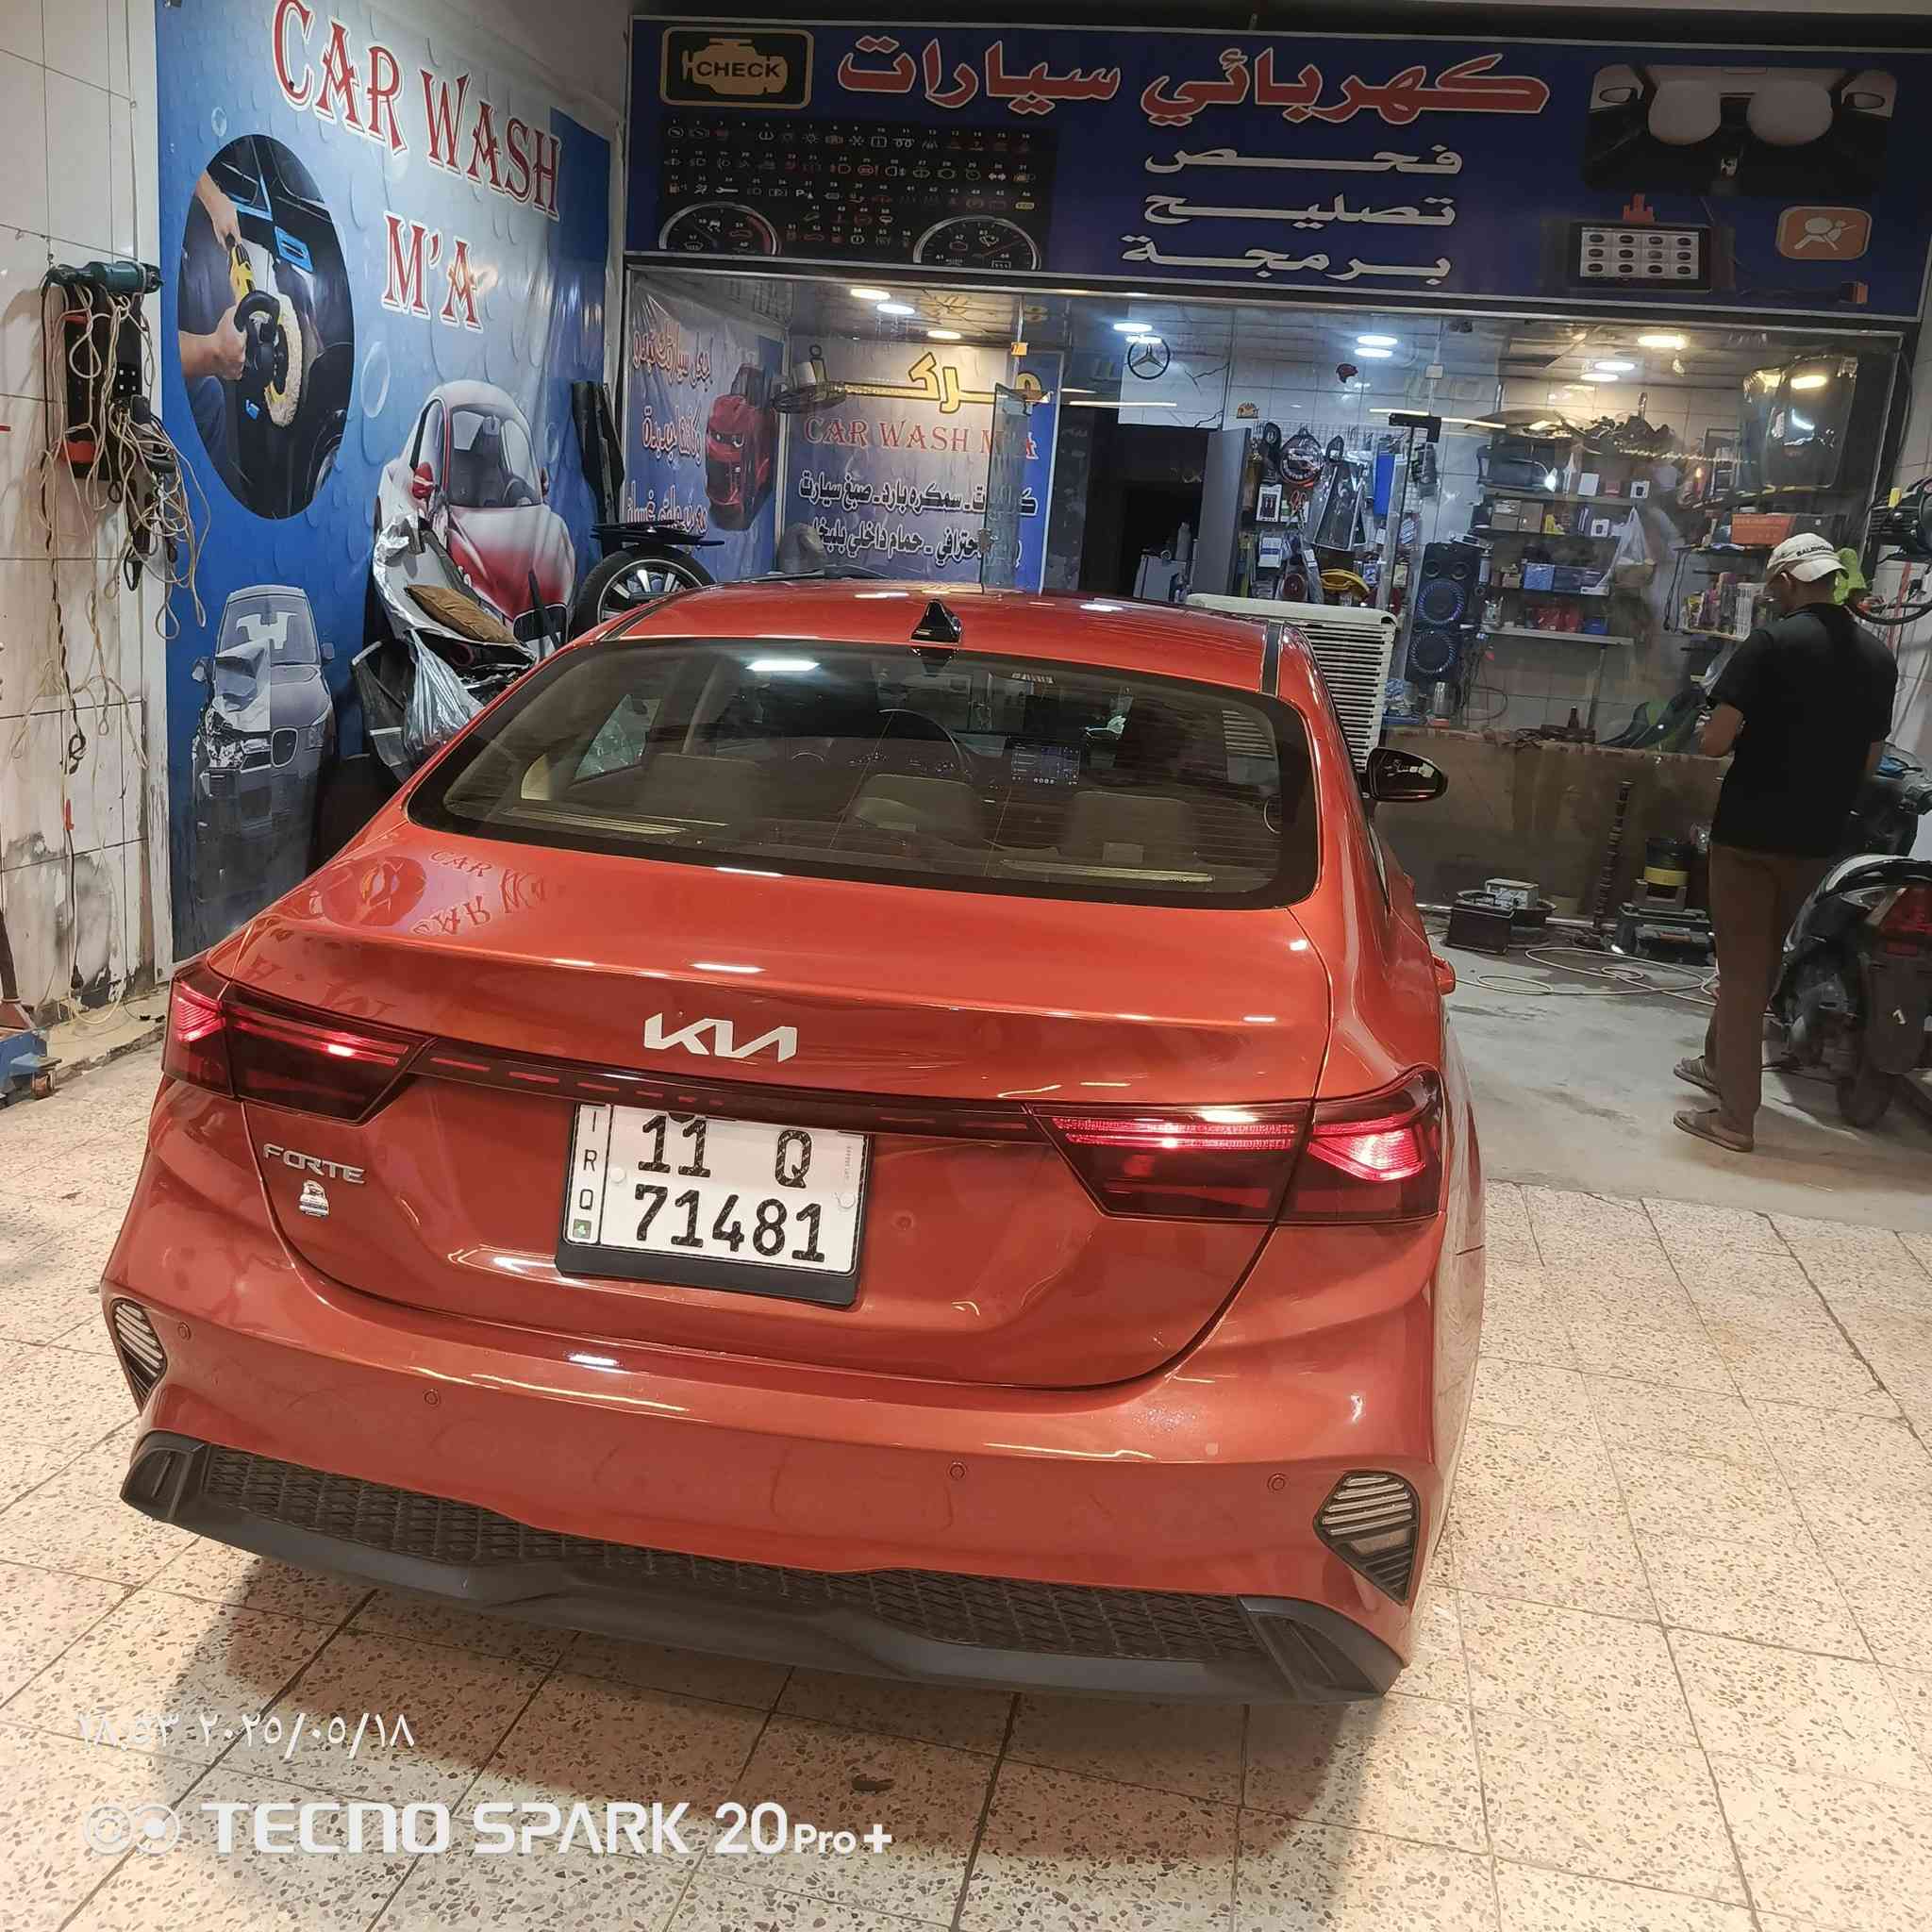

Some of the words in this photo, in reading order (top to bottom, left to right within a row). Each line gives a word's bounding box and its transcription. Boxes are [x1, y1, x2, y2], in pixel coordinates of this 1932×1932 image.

[695, 60, 781, 78] CHECK
[837, 35, 1122, 116] سيارات
[1141, 46, 1551, 126] كهربائي
[272, 0, 408, 156] CAR
[419, 68, 563, 222] WASH
[1144, 143, 1463, 175] فحص
[1143, 192, 1457, 230] تصليح
[380, 209, 484, 333] M'A
[1120, 234, 1452, 286] برمجة
[804, 414, 869, 449] CAR
[878, 418, 970, 453] WASH
[798, 468, 842, 508] سيارت
[841, 473, 874, 511] صبغ
[880, 477, 909, 514] بارد
[846, 520, 887, 558] داخلي
[887, 524, 924, 560] حمام
[262, 1142, 366, 1185] FORTE
[637, 1114, 712, 1178] 11
[774, 1128, 813, 1190] Q
[633, 1183, 825, 1263] 71481
